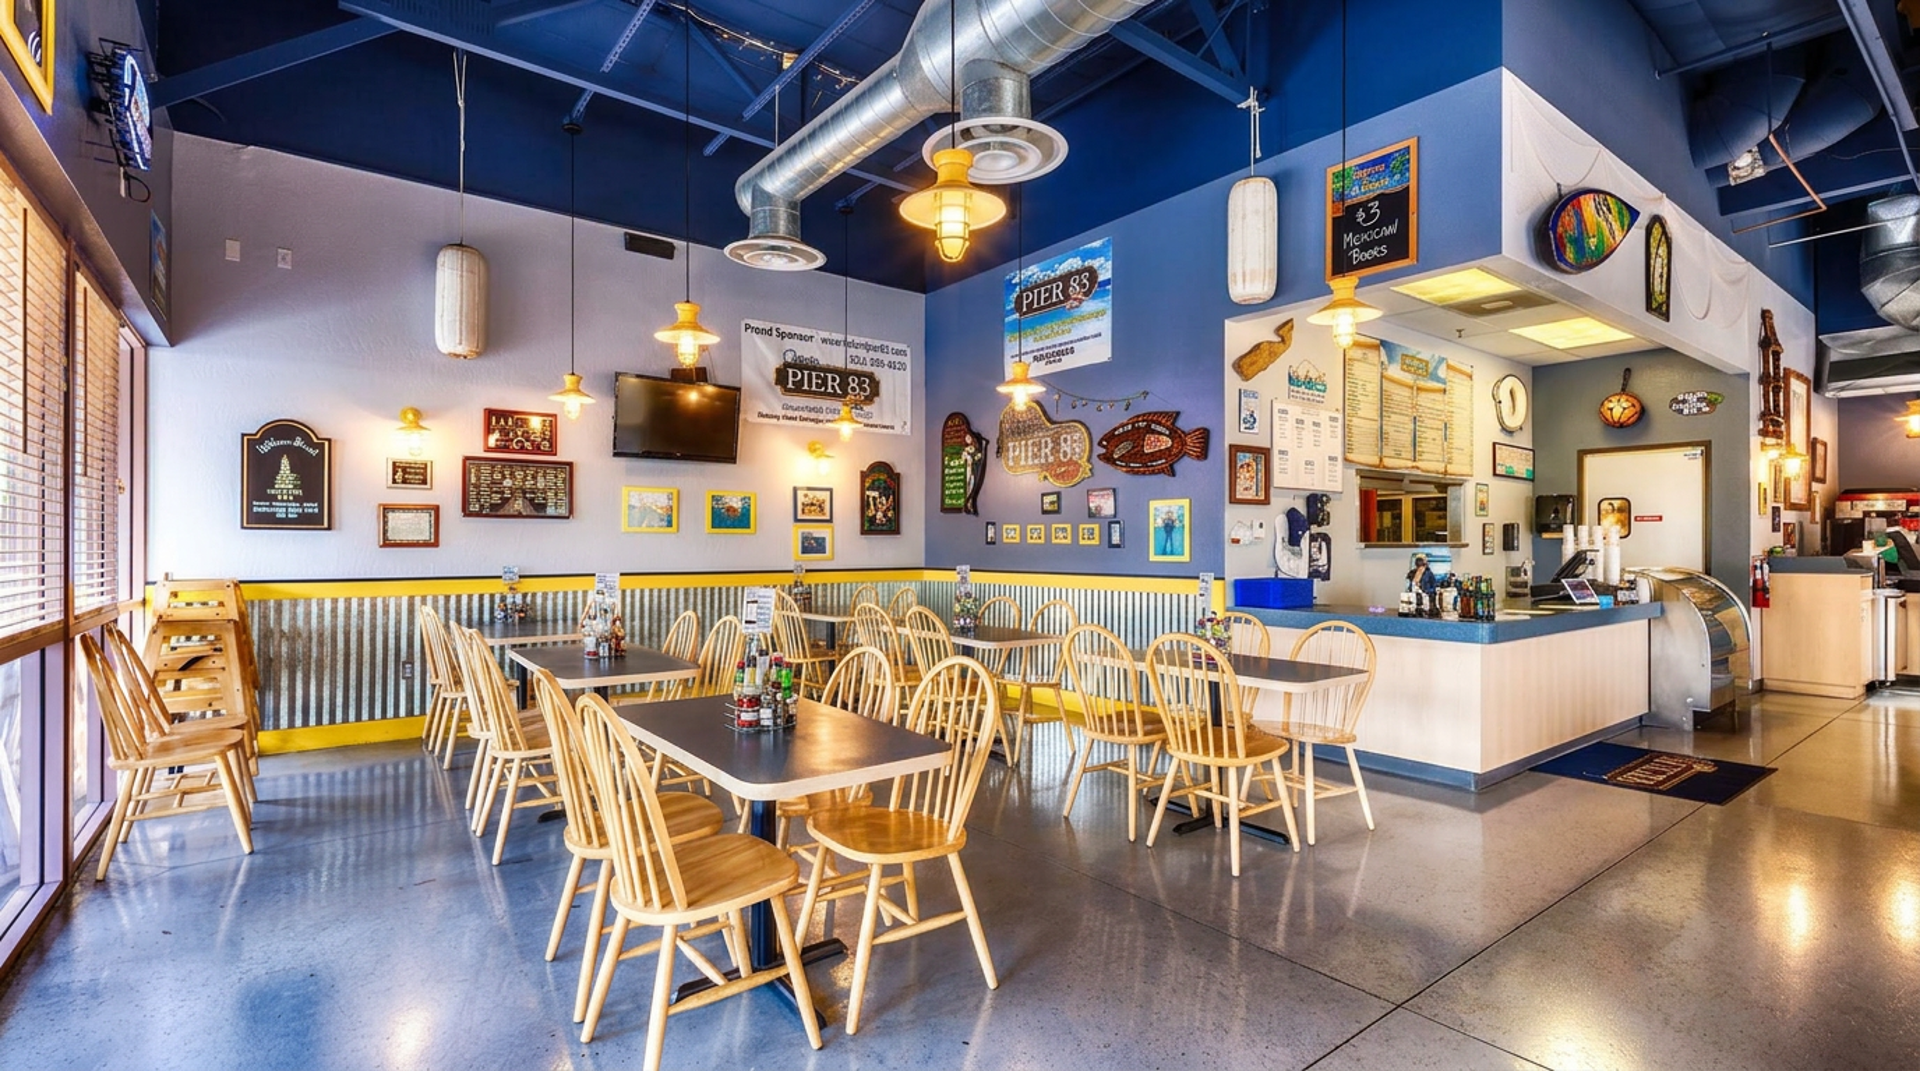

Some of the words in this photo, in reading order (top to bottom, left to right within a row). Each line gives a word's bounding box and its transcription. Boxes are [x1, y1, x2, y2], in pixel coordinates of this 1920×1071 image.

[1355, 200, 1381, 227] $3
[1021, 281, 1065, 313] PIER
[1068, 271, 1091, 296] 83
[775, 327, 815, 343] Sponsor
[786, 367, 842, 394] PIER
[847, 374, 871, 397] 83
[1007, 437, 1055, 467] PIER
[1060, 433, 1085, 463] 83
